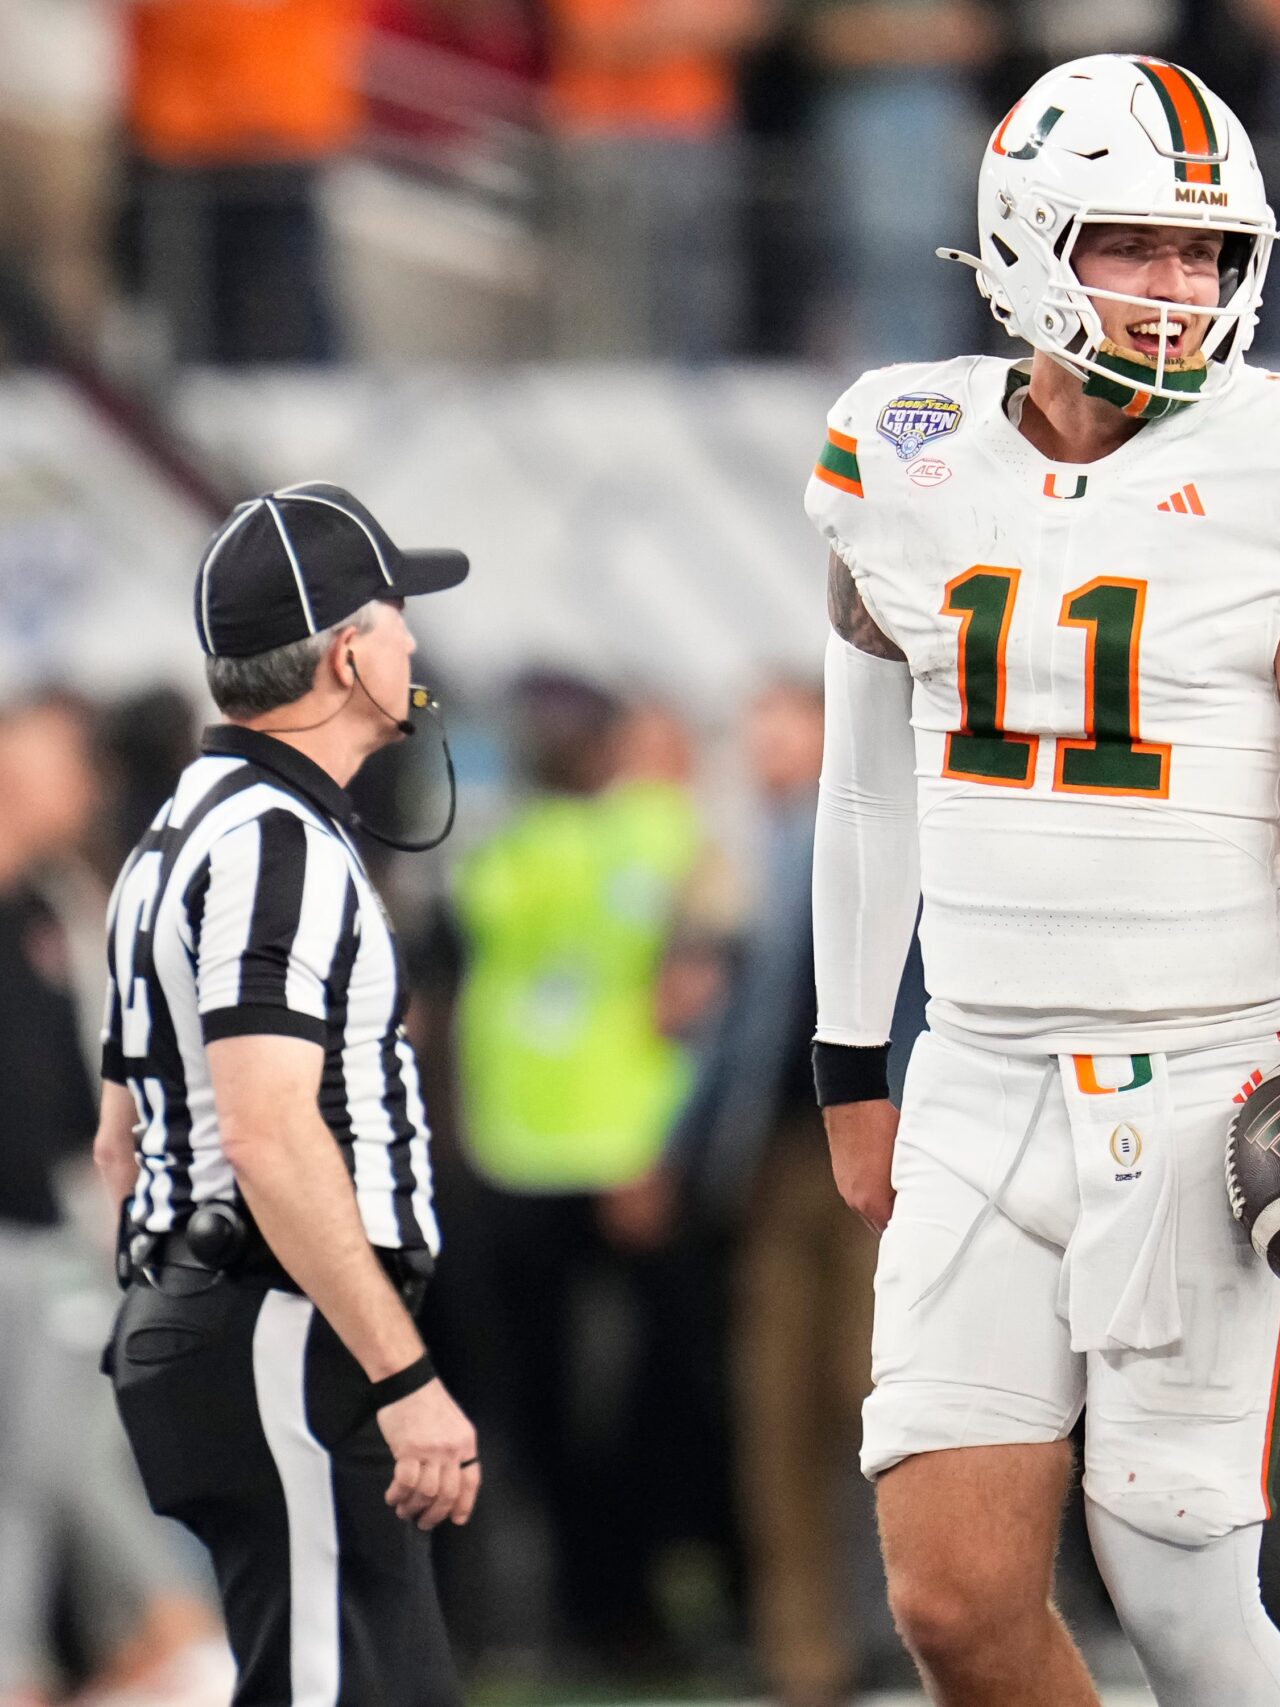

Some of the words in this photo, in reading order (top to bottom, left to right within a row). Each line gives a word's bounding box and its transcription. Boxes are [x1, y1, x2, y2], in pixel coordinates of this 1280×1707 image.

[1175, 188, 1228, 207] MIAMI
[881, 409, 957, 431] COTTON
[891, 422, 938, 436] BOWL
[913, 465, 946, 476] ACC
[1043, 473, 1088, 499] U
[937, 564, 1172, 799] 11
[1071, 1053, 1153, 1095] U
